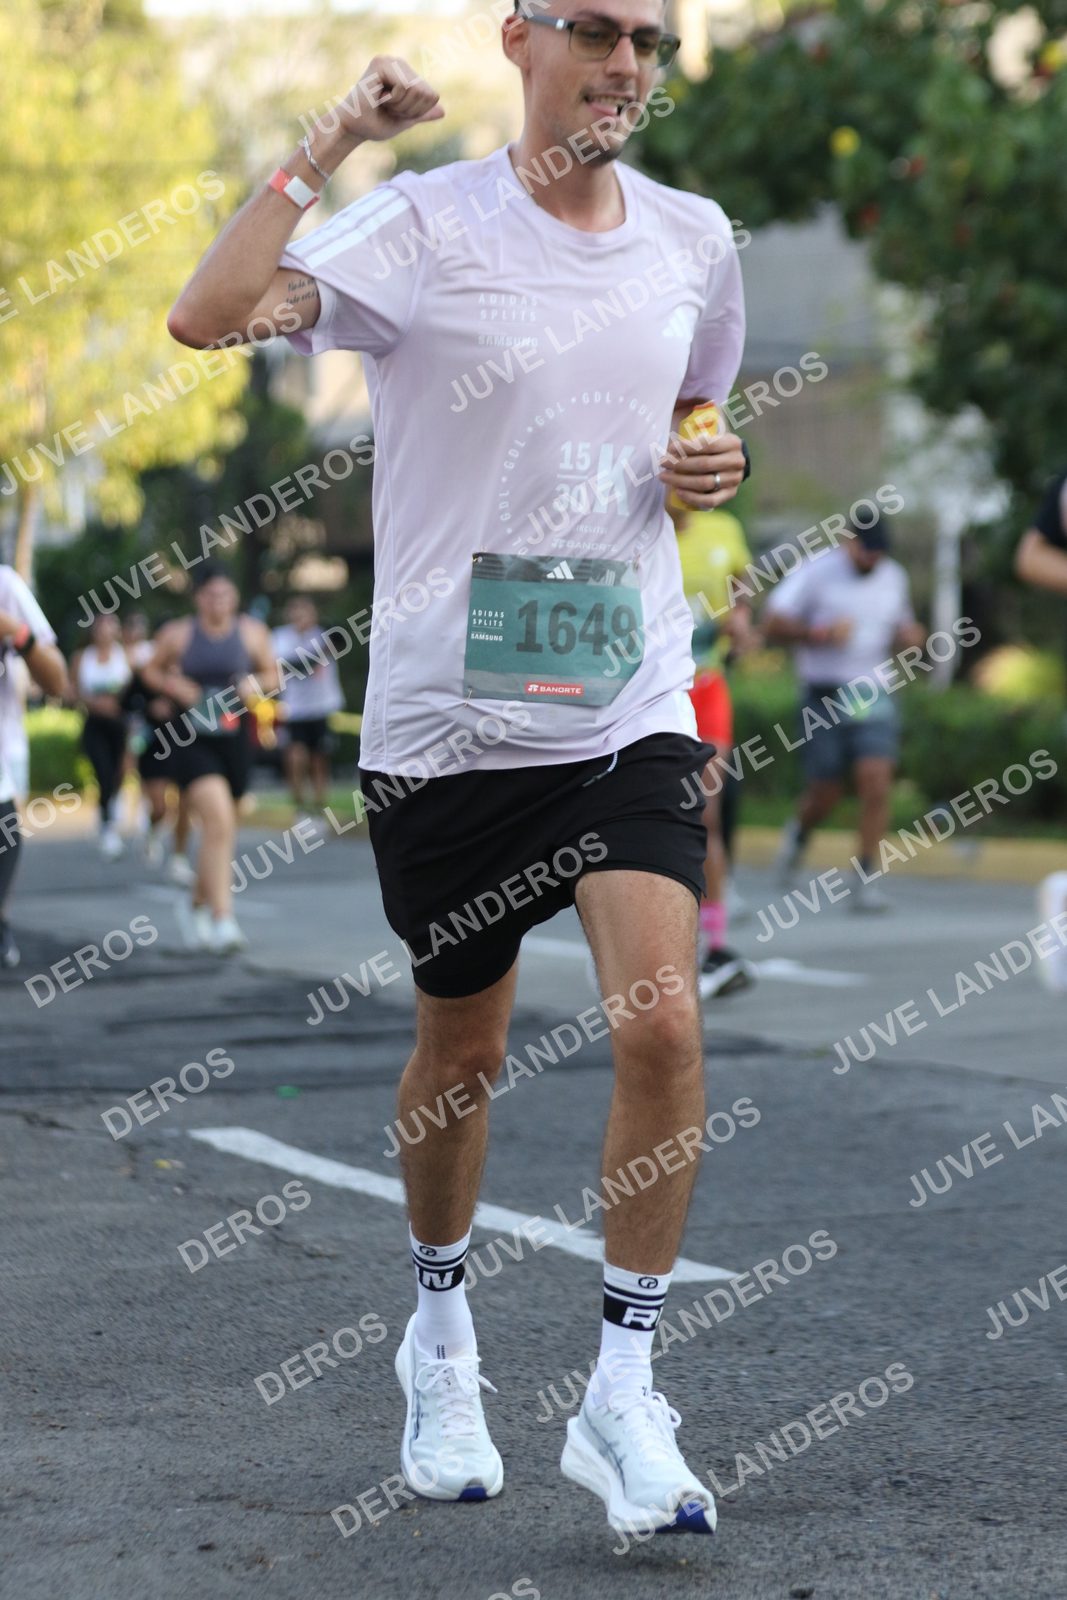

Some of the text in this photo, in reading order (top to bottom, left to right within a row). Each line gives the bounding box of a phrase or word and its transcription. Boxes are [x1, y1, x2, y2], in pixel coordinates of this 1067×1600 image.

[478, 293, 538, 306] ADIDAS
[480, 309, 537, 322] SPLITS
[478, 335, 539, 347] SAMSUNG
[581, 391, 612, 405] GDL
[534, 401, 566, 426] GDL
[559, 440, 592, 471] 15
[593, 443, 636, 516] K
[472, 609, 505, 618] ADIDAS
[472, 618, 504, 627] SPLITS
[516, 600, 638, 657] 1649
[470, 633, 503, 642] SAMSUNG
[539, 686, 582, 694] BANORTE
